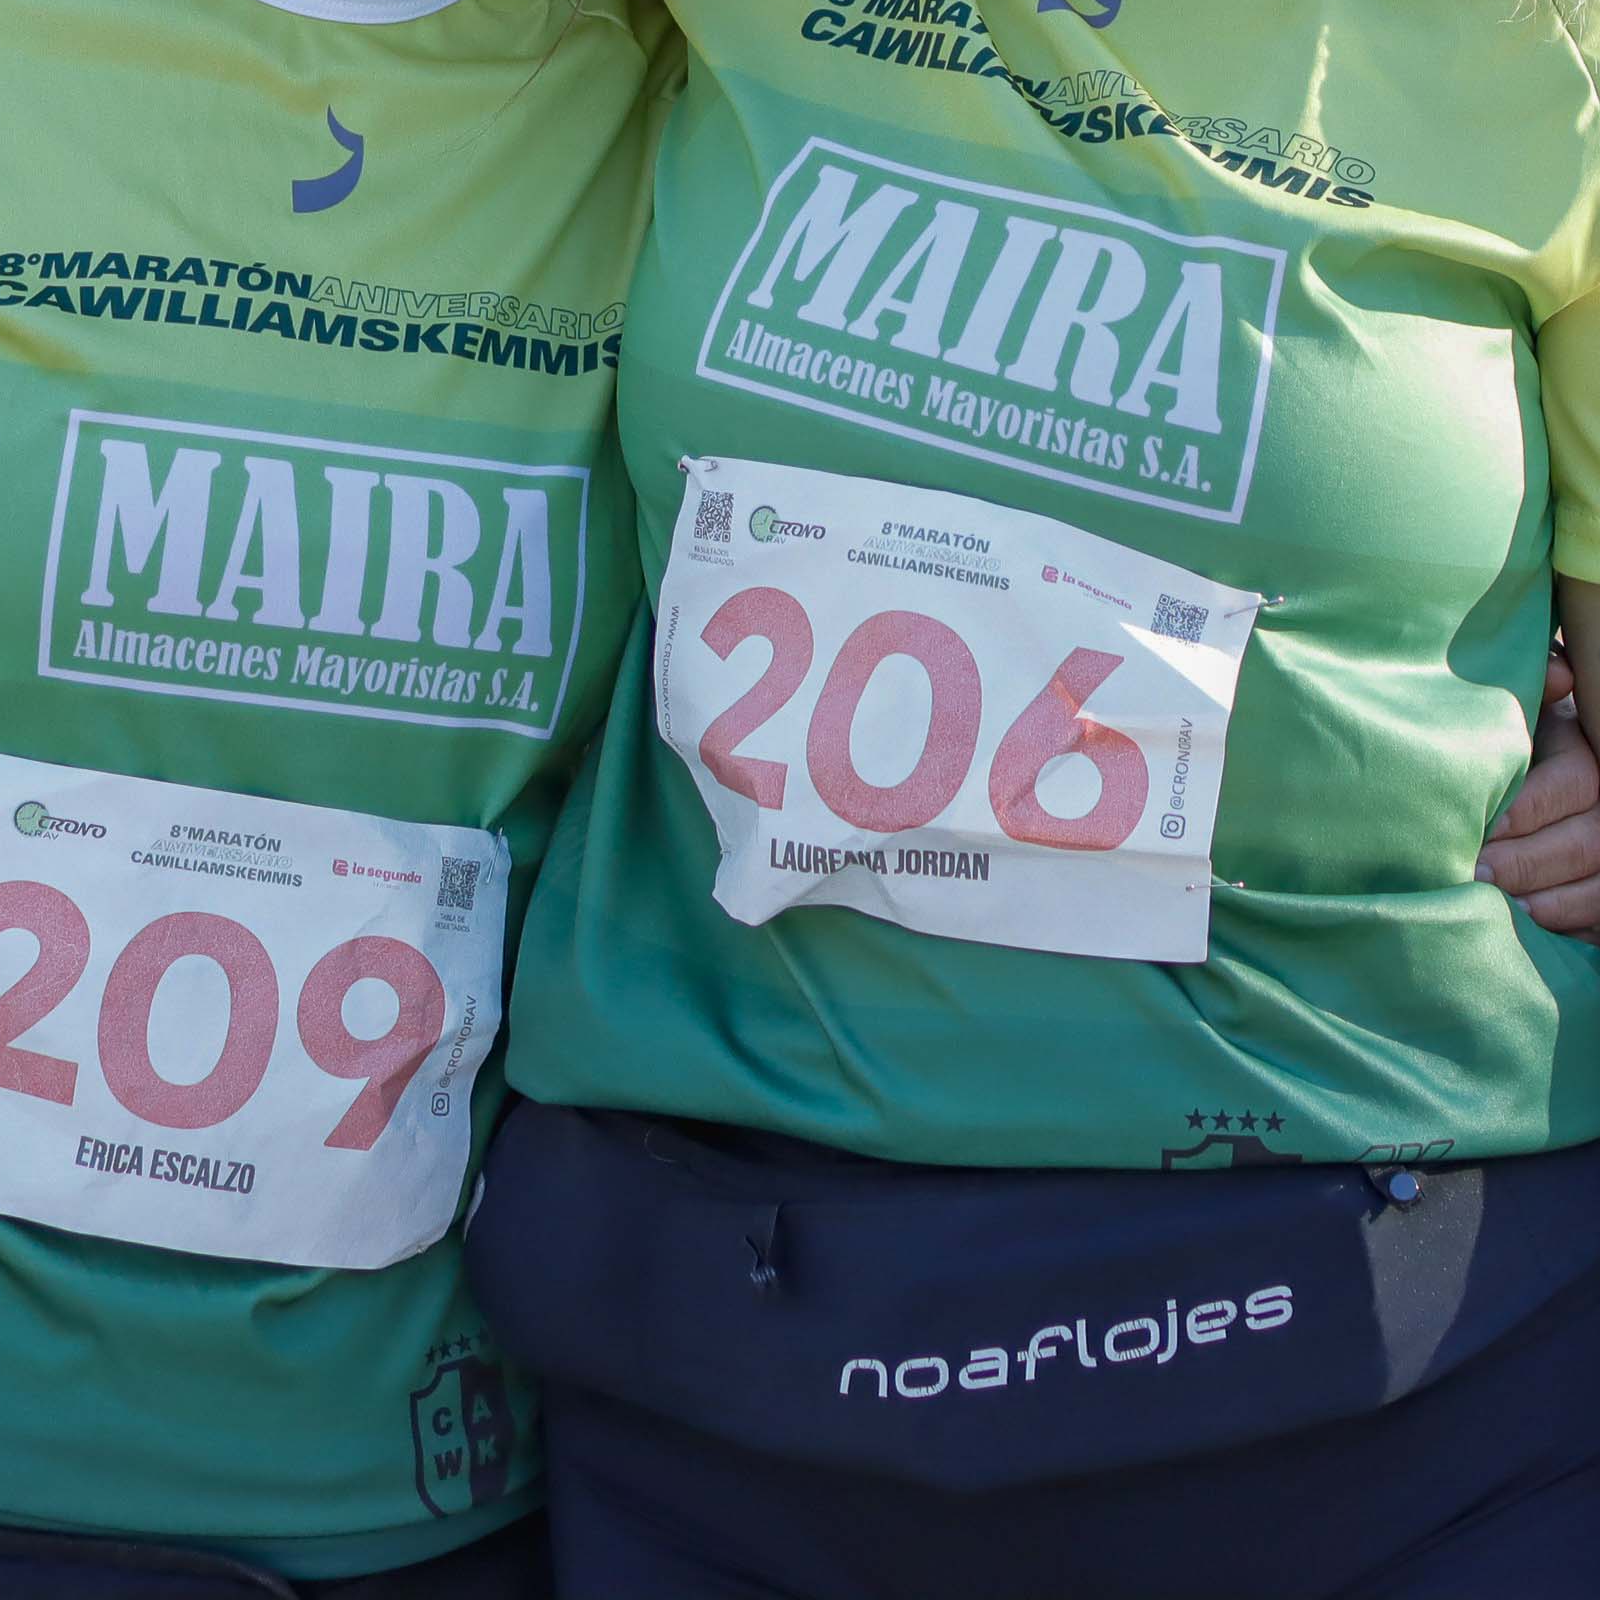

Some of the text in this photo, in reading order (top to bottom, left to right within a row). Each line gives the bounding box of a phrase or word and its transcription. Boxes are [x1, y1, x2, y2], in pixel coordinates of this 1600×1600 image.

[746, 164, 1222, 434] MAIRA
[725, 318, 1212, 492] Almacenes Mayoristas S.A.
[80, 438, 554, 657] MAIRA
[769, 519, 826, 540] CRONO
[847, 548, 1011, 591] CAWILLIAMSKEMMIS
[73, 618, 540, 712] Almacenes Mayoristas S.A.
[699, 586, 1150, 851] 206
[1169, 717, 1193, 810] @CRONORAV
[37, 815, 108, 839] CRONO
[894, 849, 990, 881] JORDAN
[131, 850, 303, 888] CAWILLIAMSKEMMIS
[352, 862, 422, 884] la segunda
[75, 1135, 256, 1194] ERICA ESCALZO
[840, 1285, 1294, 1398] noaflojes
